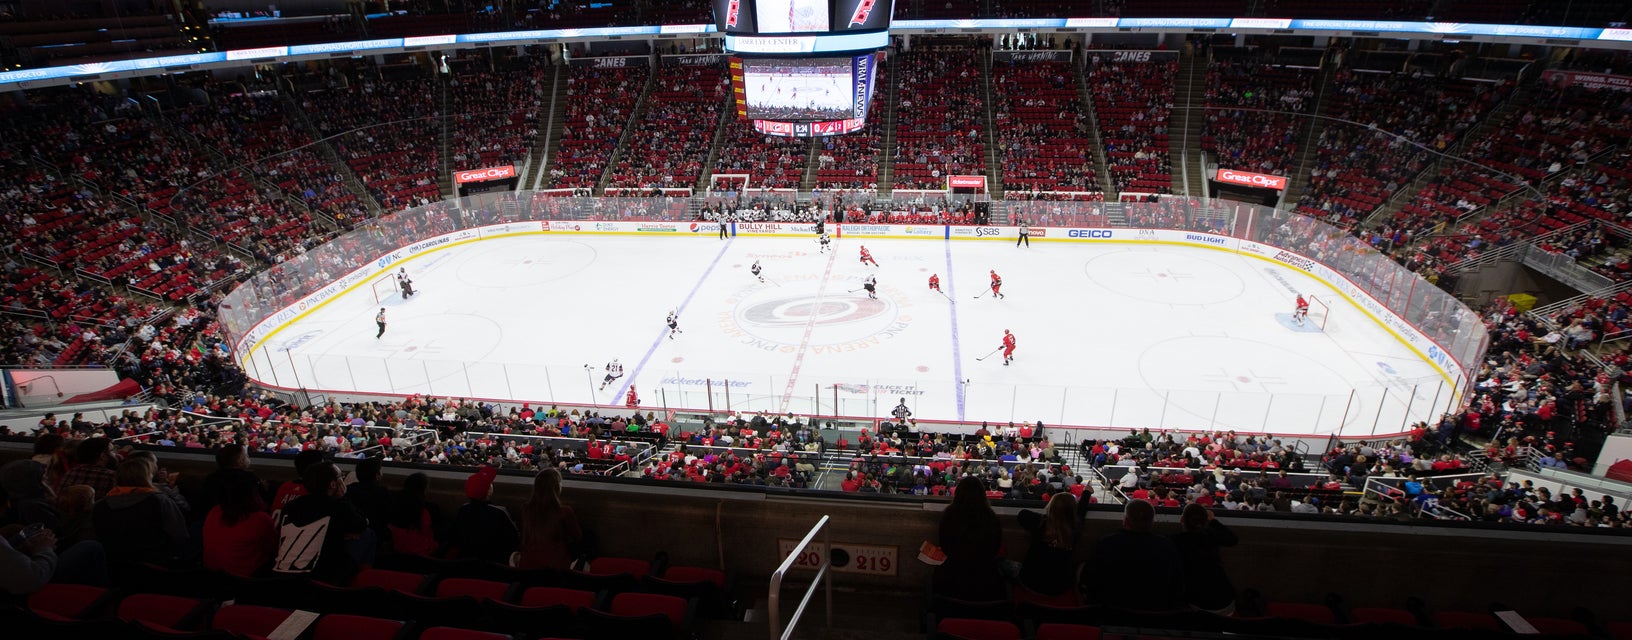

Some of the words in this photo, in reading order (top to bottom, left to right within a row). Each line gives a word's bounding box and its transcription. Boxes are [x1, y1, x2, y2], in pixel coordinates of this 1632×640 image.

[1113, 51, 1151, 62] CANES
[594, 58, 626, 68] CANES
[857, 86, 865, 117] NEWS
[461, 171, 487, 181] Great
[488, 168, 510, 178] Clips
[1222, 171, 1251, 182] Great
[1252, 175, 1280, 187] Clips
[701, 224, 720, 233] peps
[1068, 229, 1112, 238] GEICO
[1186, 234, 1203, 242] BUD
[1203, 236, 1225, 245] LIGHT
[611, 364, 618, 372] 21
[856, 555, 891, 572] 219
